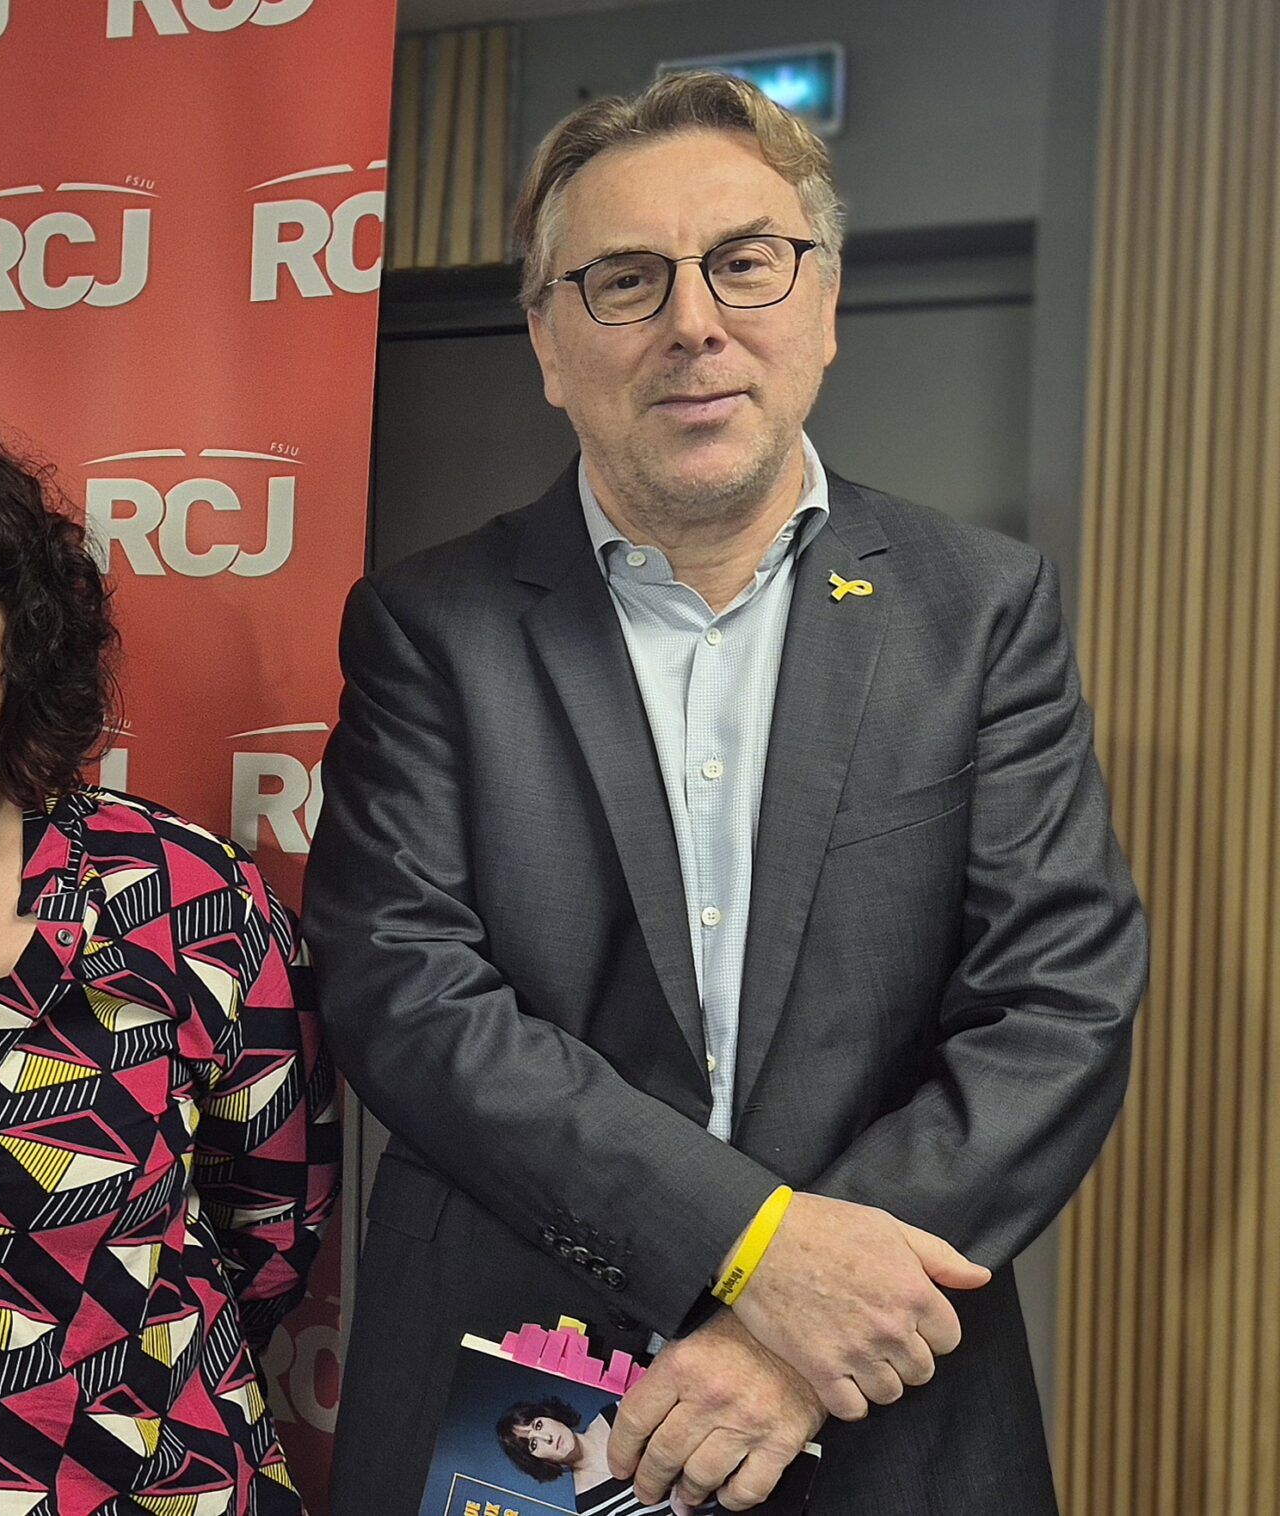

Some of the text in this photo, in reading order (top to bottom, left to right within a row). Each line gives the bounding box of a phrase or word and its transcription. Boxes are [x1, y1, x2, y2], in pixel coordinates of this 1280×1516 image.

[125, 175, 155, 190] FSJU
[270, 442, 299, 457] FSJU
[83, 476, 296, 577] RCJ
[230, 752, 324, 855] R
